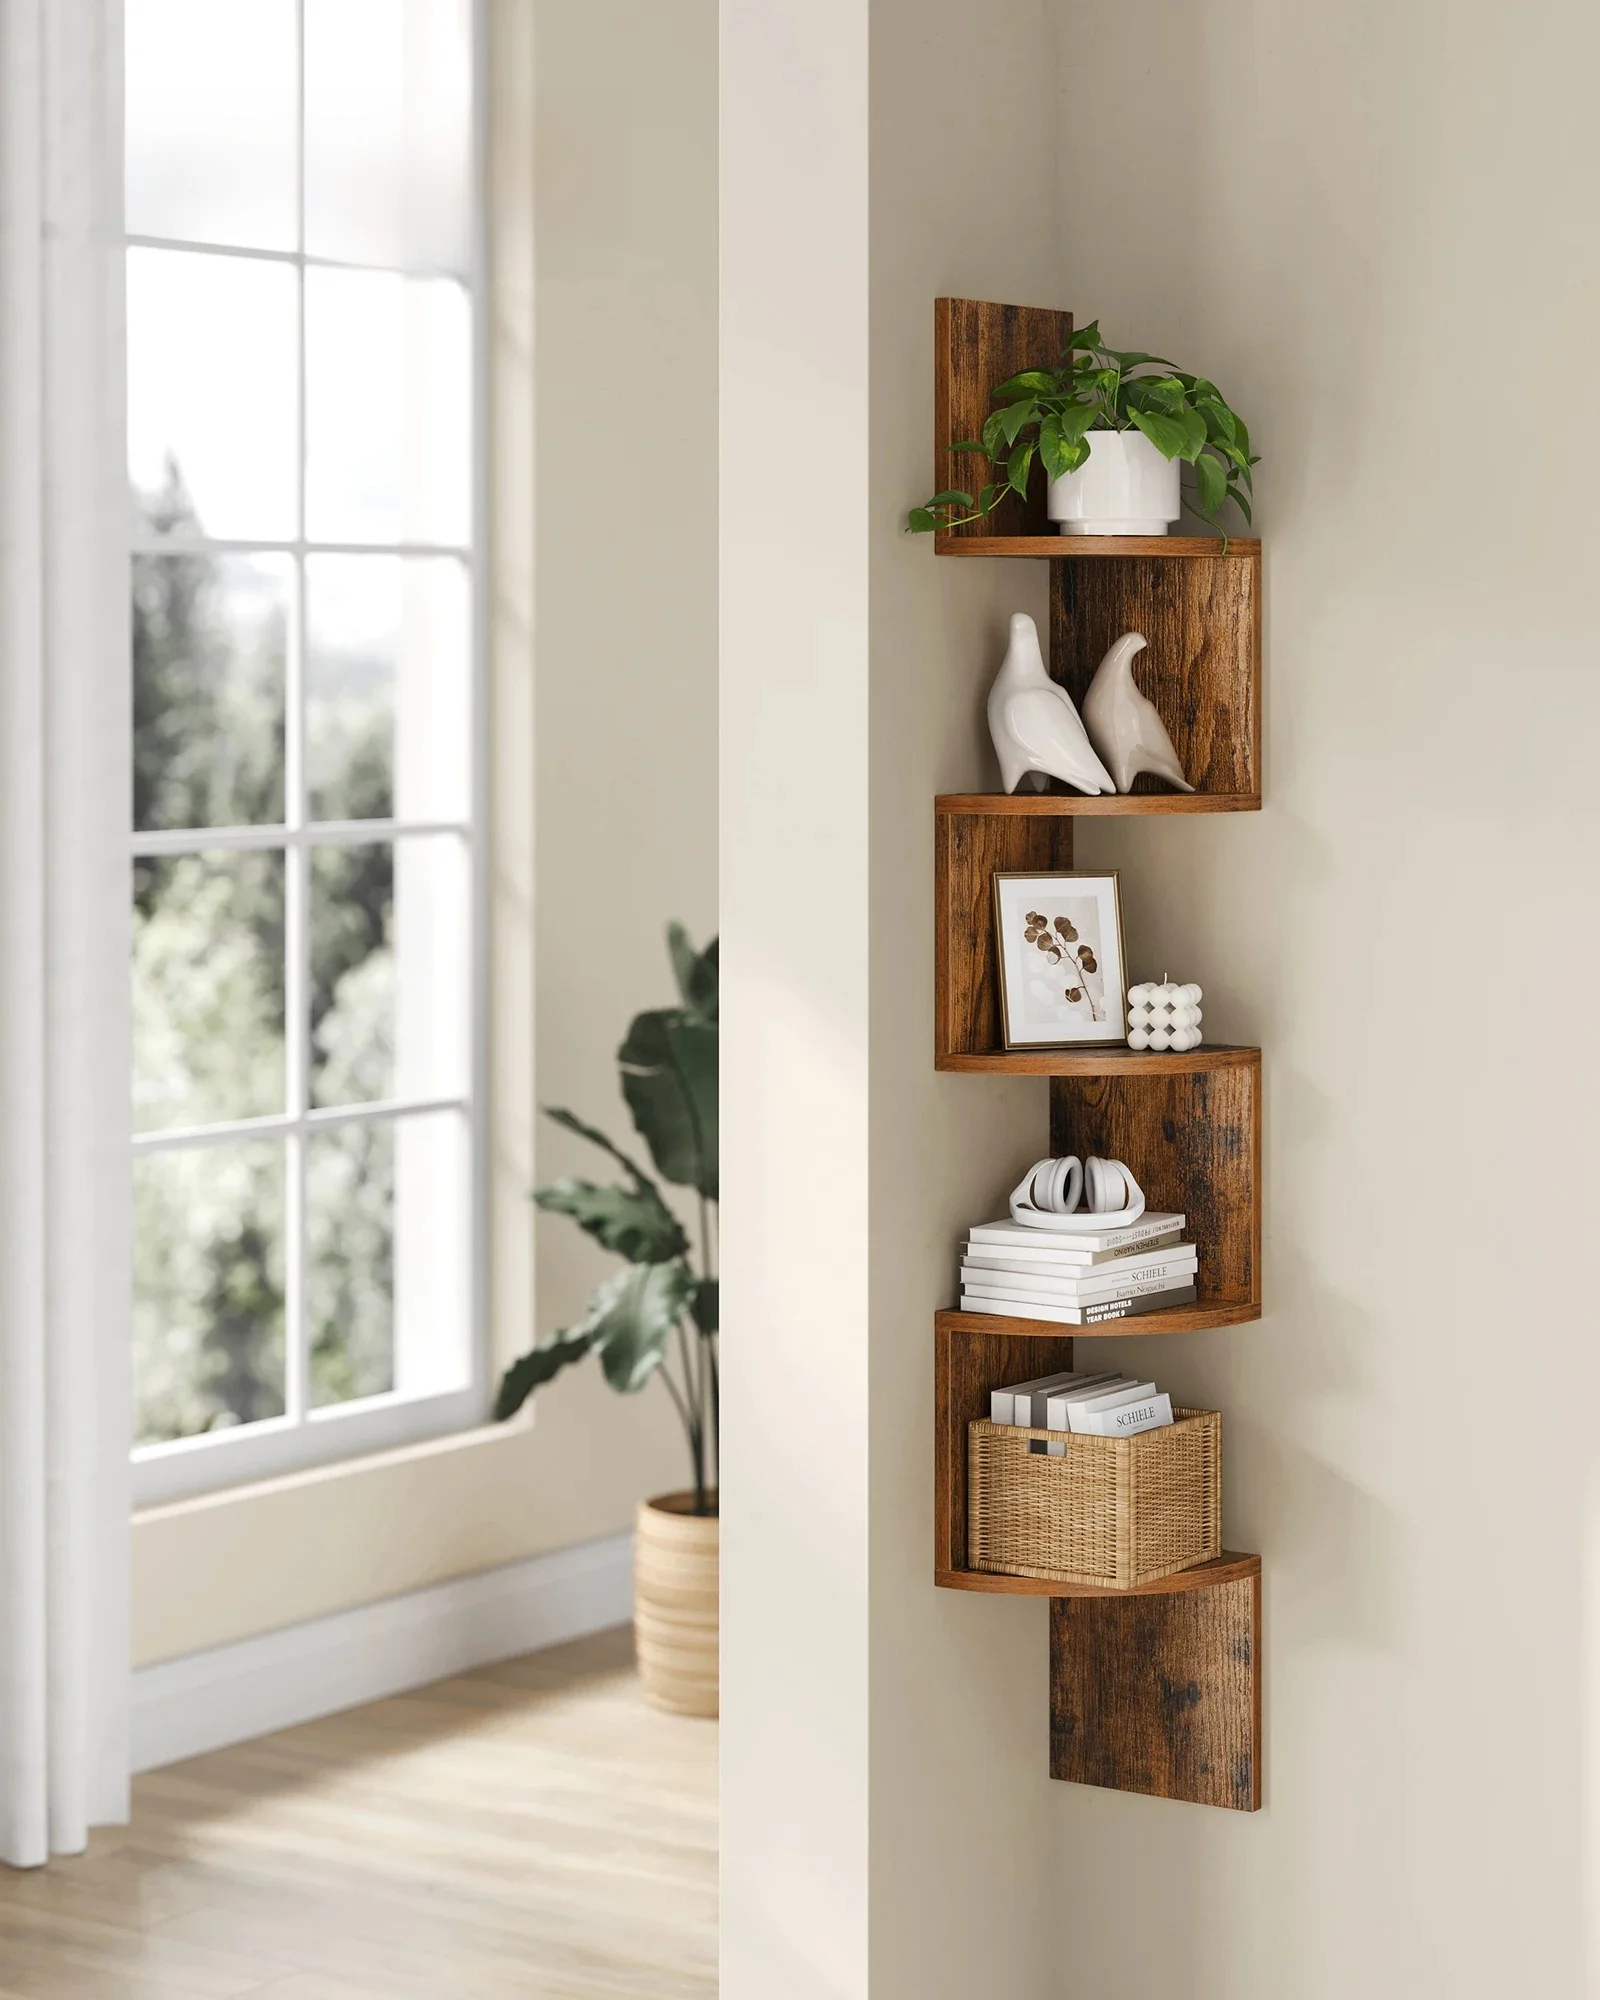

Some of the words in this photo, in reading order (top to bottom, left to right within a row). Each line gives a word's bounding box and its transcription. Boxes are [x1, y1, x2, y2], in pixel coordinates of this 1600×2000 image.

[1113, 1244, 1136, 1257] MARINO
[1136, 1238, 1160, 1251] STEPHEN
[1131, 1266, 1168, 1282] SCHIELE
[1116, 1289, 1136, 1298] Isamu
[1137, 1283, 1166, 1295] Noguchi
[1086, 1304, 1109, 1315] DESIGN
[1109, 1299, 1132, 1310] HOTELS
[1086, 1314, 1103, 1324] YEAR
[1103, 1311, 1121, 1321] BOOK
[1121, 1309, 1126, 1317] 9
[1116, 1406, 1156, 1428] SCHIELE
